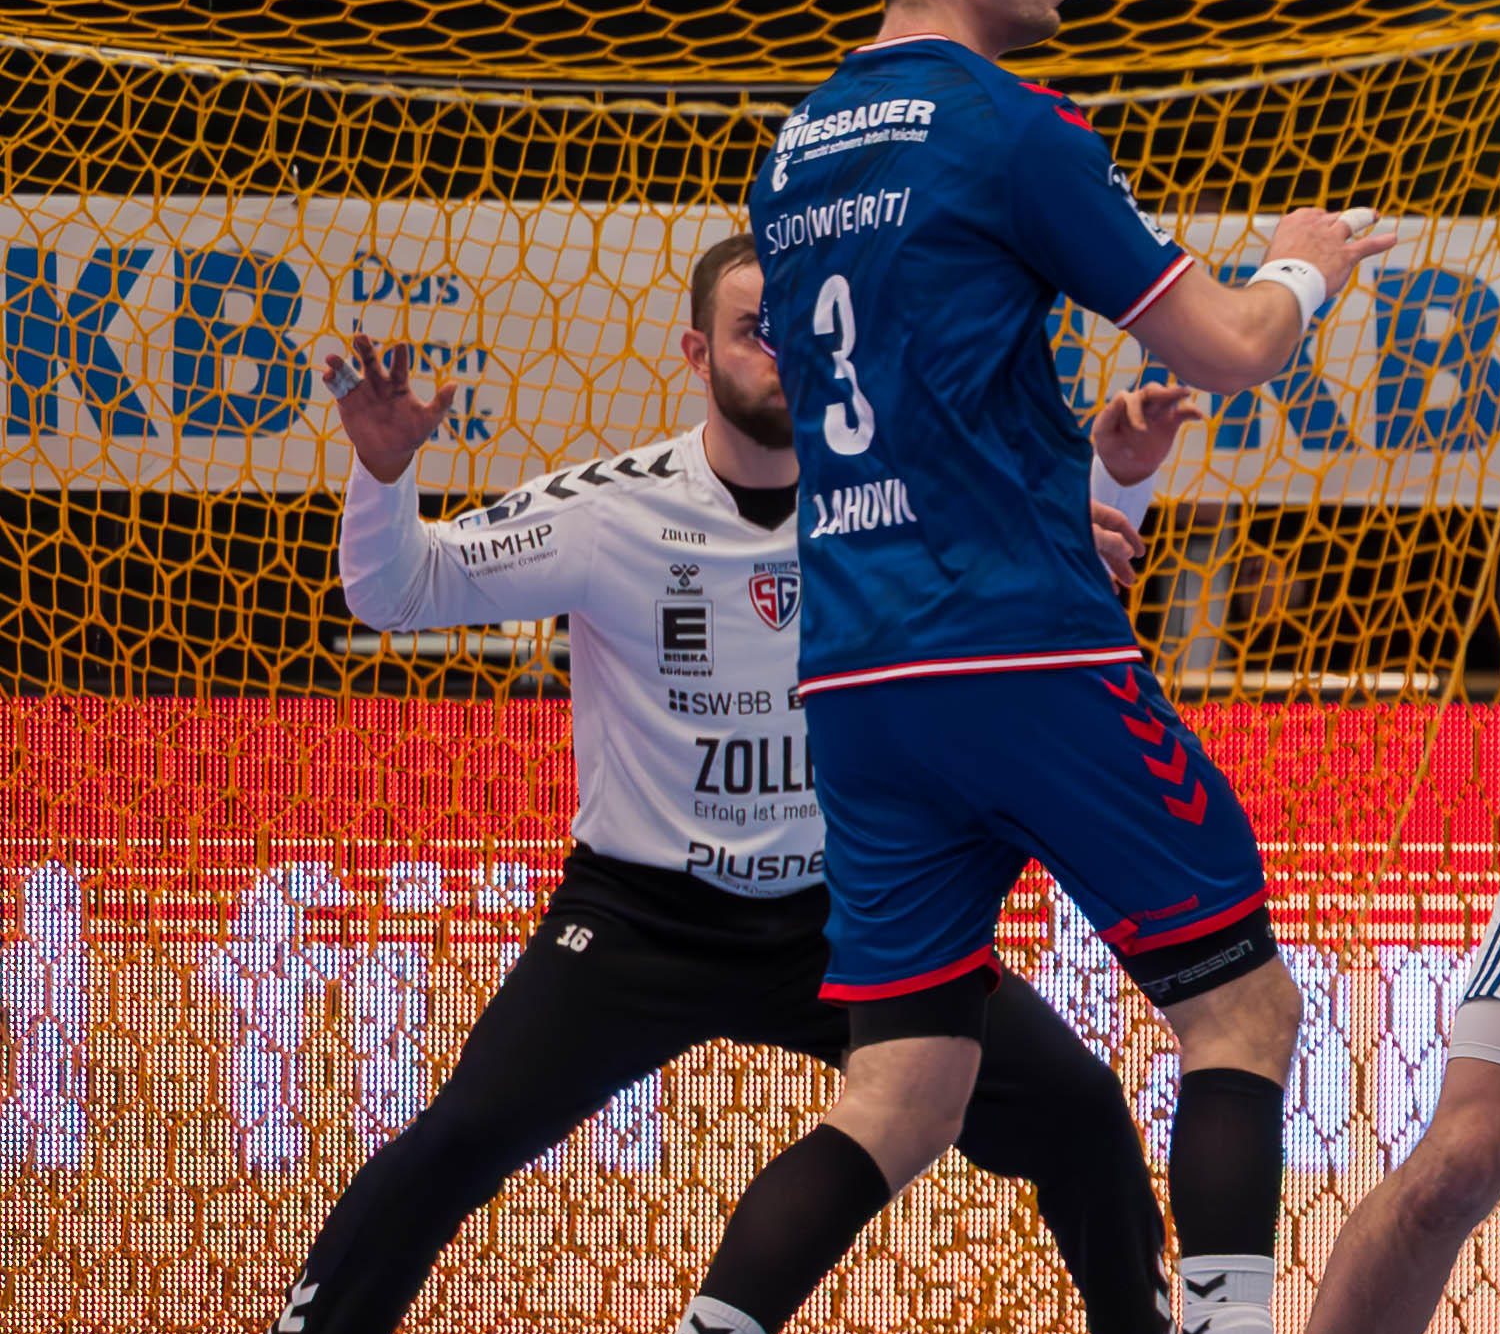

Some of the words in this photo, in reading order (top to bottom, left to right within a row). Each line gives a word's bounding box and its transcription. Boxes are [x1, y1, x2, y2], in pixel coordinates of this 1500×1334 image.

[776, 99, 936, 154] WIESBAUER
[812, 274, 876, 455] 3
[491, 523, 552, 559] MHP
[661, 527, 707, 545] ZOLLER
[695, 736, 815, 796] ZOLL
[694, 800, 747, 827] Erfolg
[754, 803, 776, 821] ist
[686, 841, 824, 882] Plusne
[556, 923, 594, 953] 16
